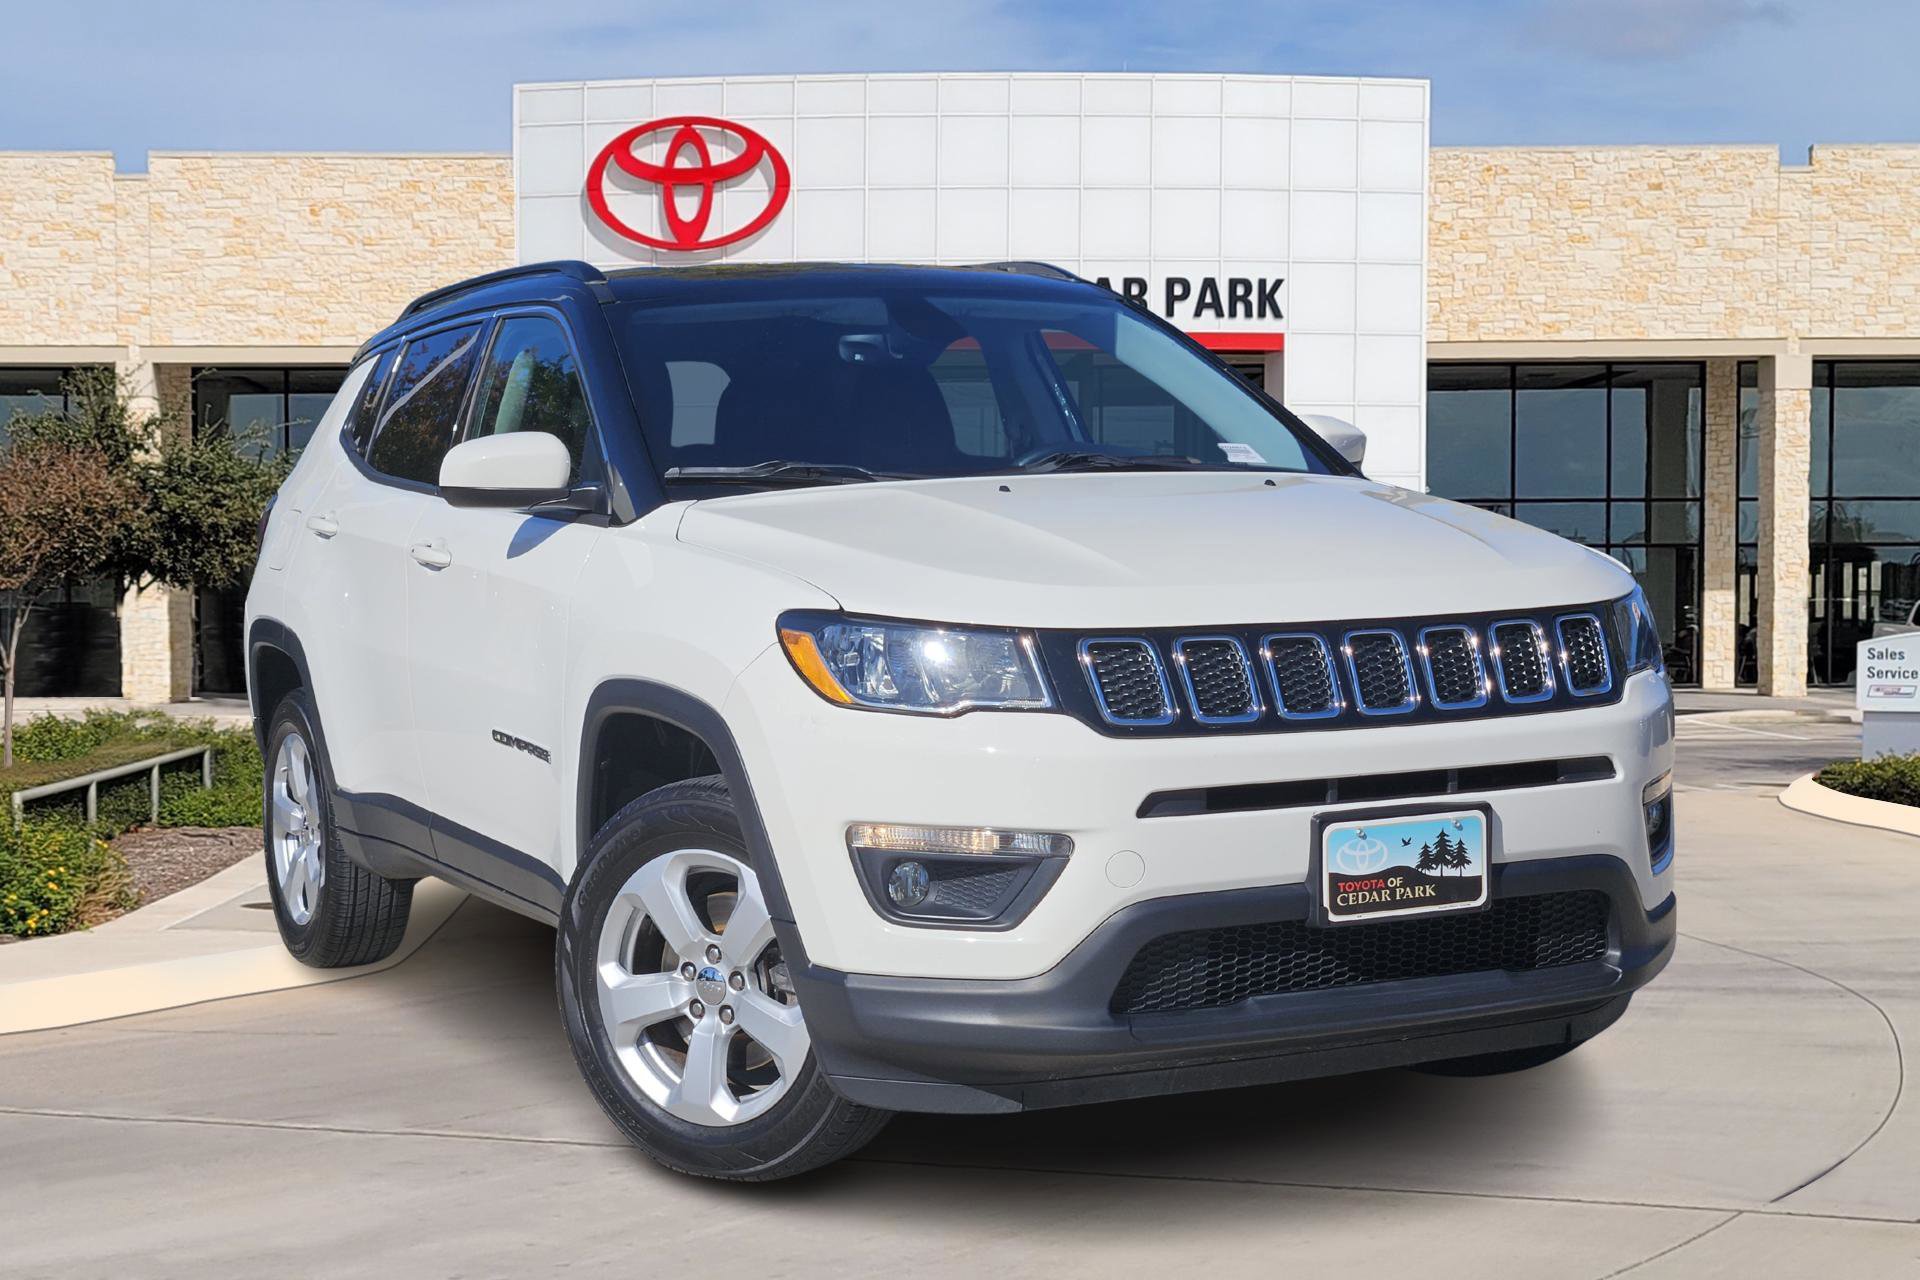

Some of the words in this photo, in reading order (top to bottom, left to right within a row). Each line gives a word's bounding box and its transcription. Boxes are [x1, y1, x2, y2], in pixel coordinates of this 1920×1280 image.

[1165, 277, 1285, 319] PARK
[1866, 647, 1906, 660] Sales
[1866, 666, 1919, 679] Service
[1337, 878, 1385, 892] TOYOTA
[1387, 876, 1404, 887] OF
[1336, 889, 1391, 906] CEDAR
[1395, 884, 1436, 900] PARK
